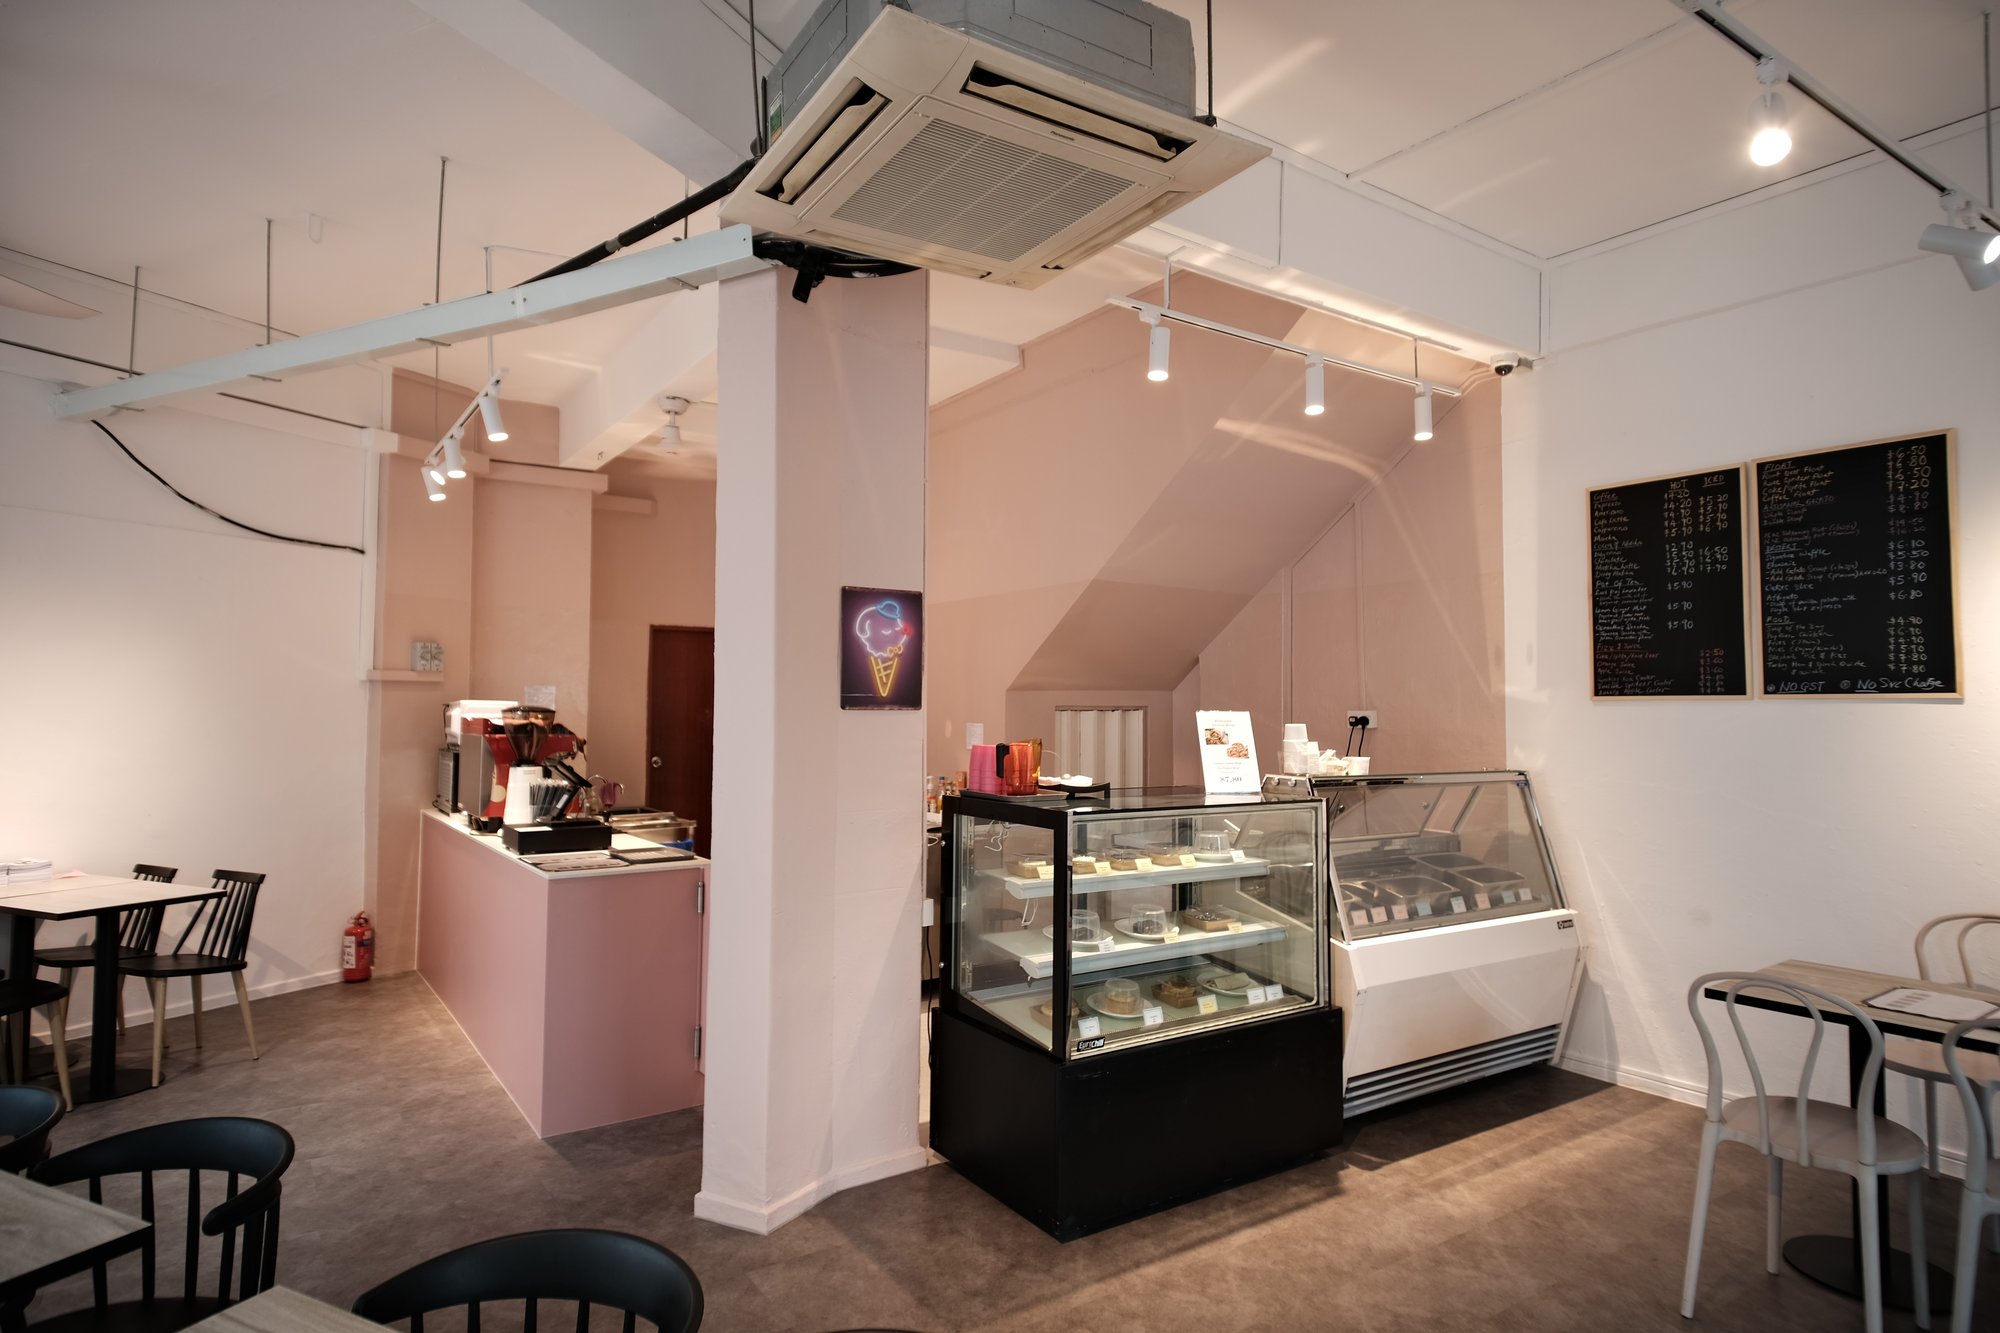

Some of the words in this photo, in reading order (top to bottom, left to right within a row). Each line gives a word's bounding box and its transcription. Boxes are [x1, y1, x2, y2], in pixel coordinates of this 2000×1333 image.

[1670, 479, 1688, 490] HOT
[1704, 474, 1725, 486] ICED
[1779, 682, 1798, 693] NO
[1800, 680, 1827, 692] GST
